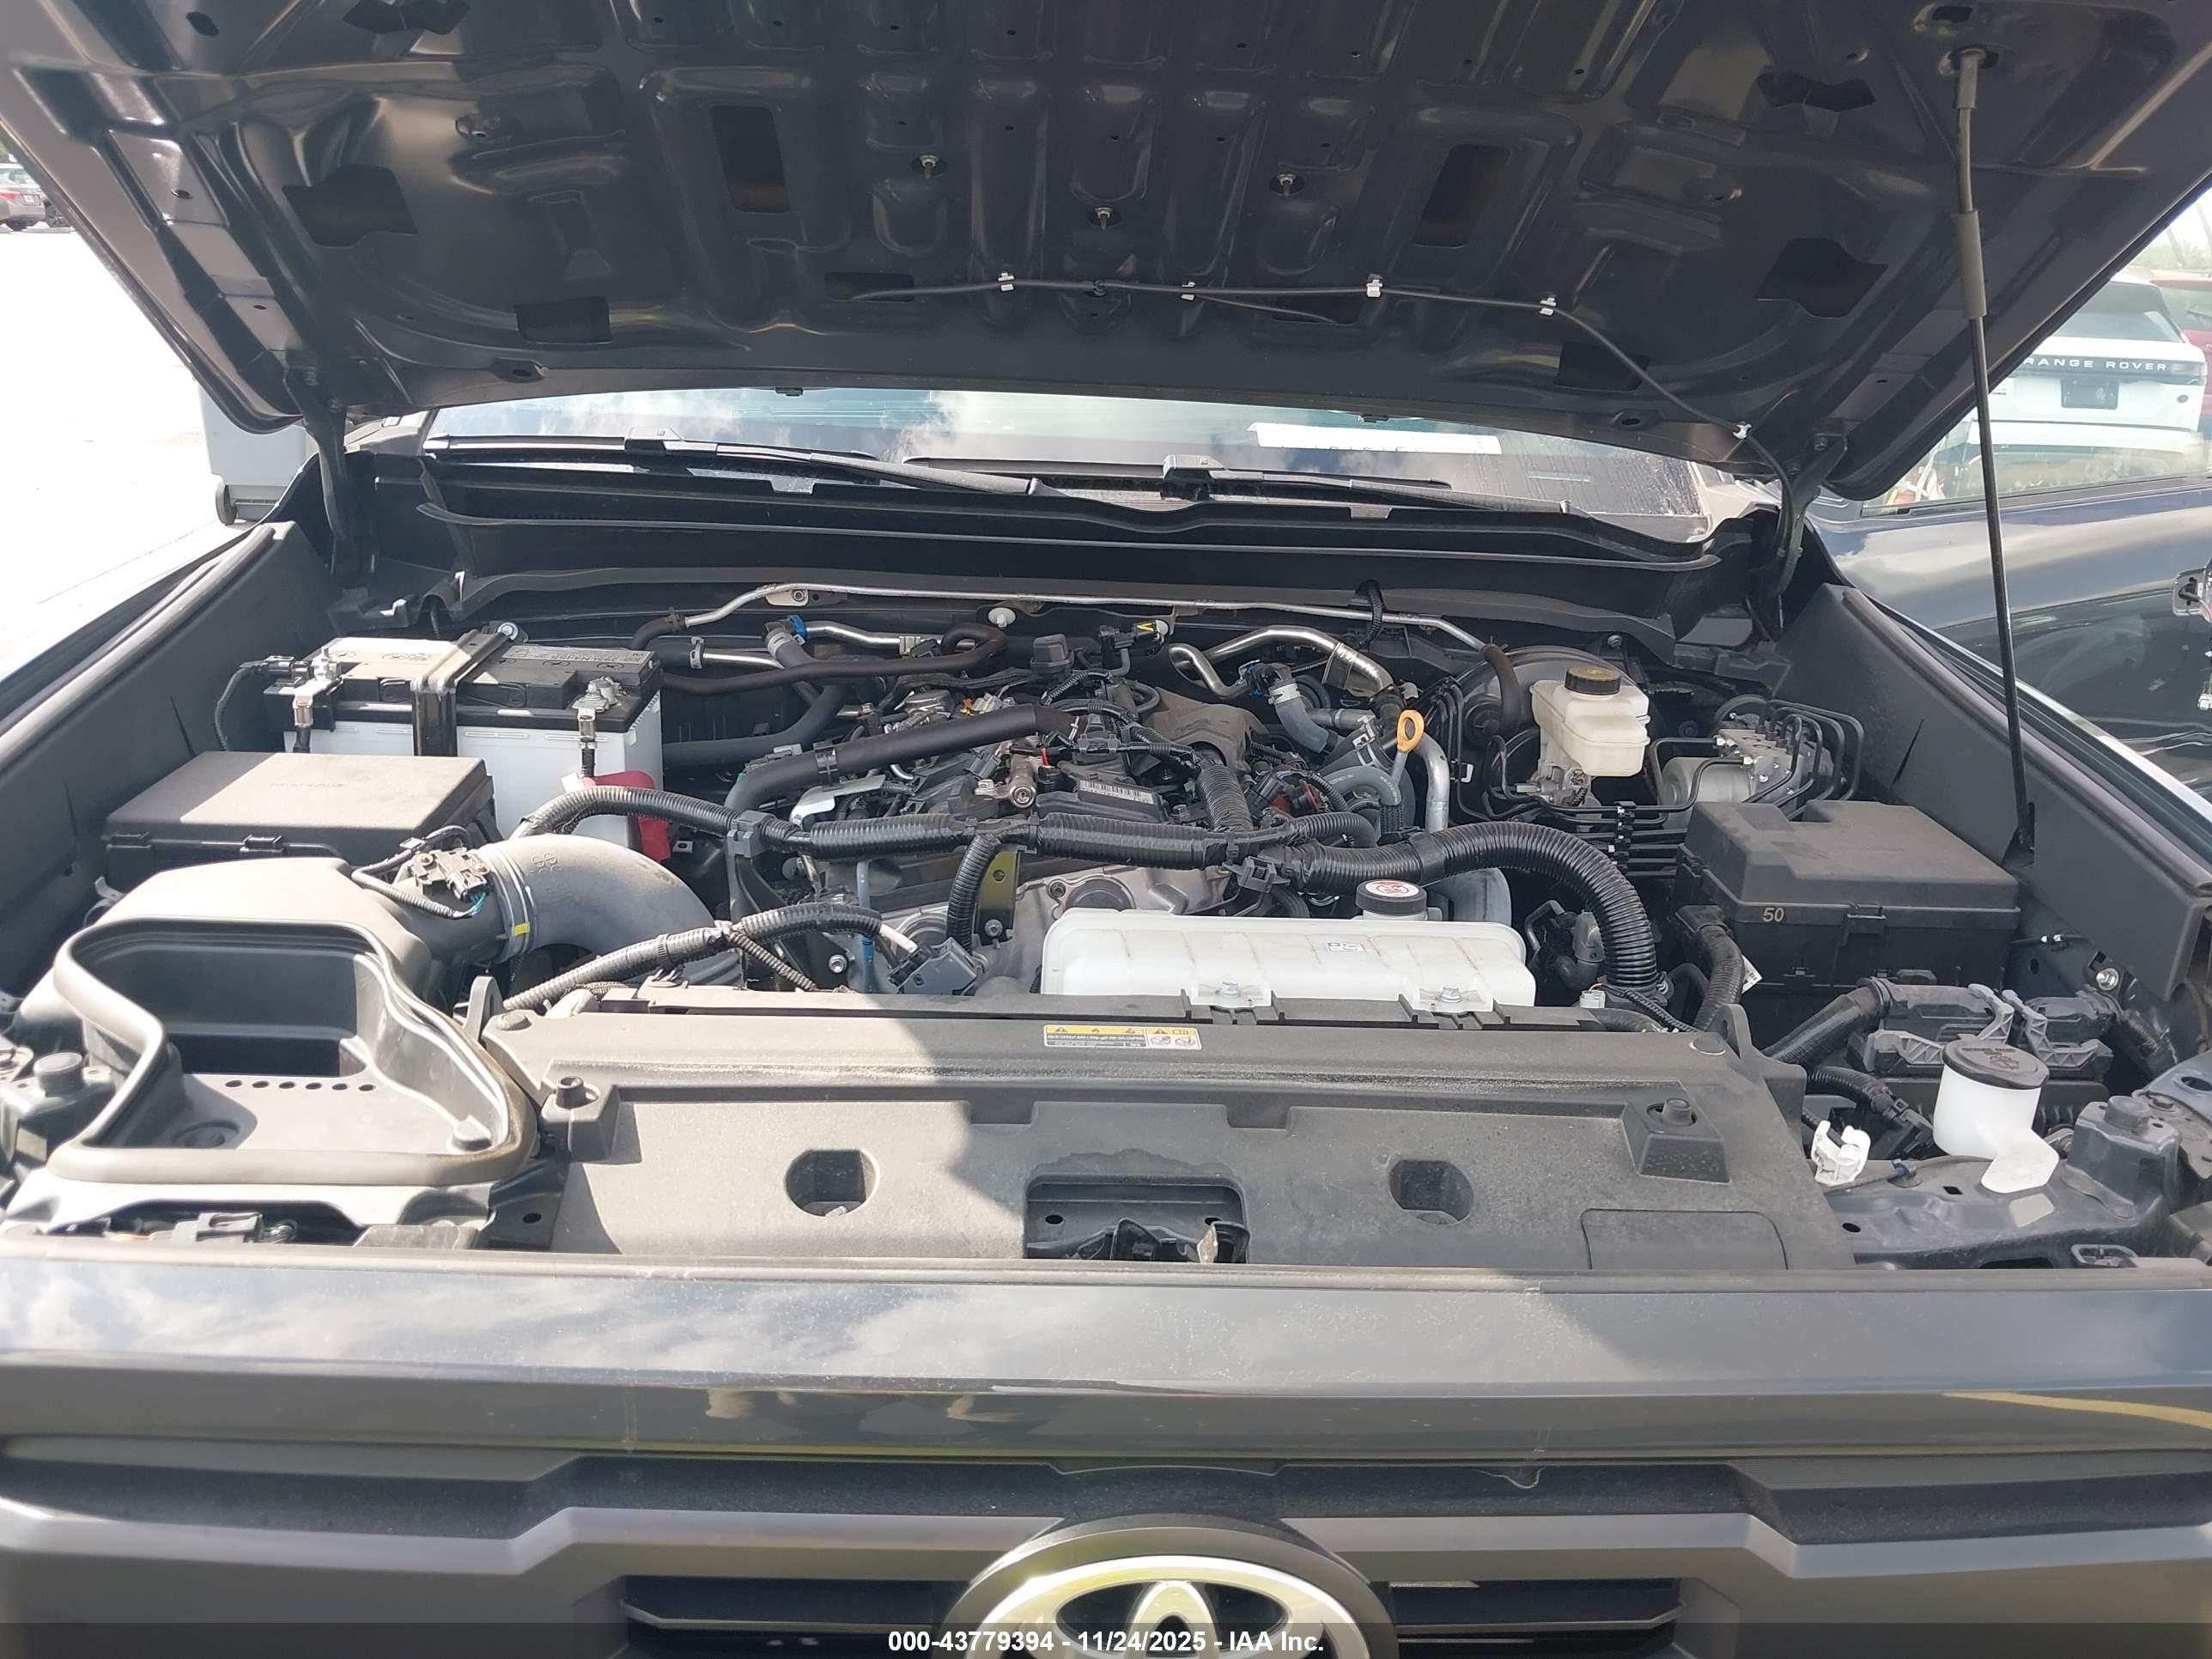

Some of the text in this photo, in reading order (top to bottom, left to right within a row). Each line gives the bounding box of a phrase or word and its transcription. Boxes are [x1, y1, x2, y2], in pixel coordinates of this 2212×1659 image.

[2023, 356, 2167, 371] RANGE ROVER
[1762, 907, 1784, 922] 50
